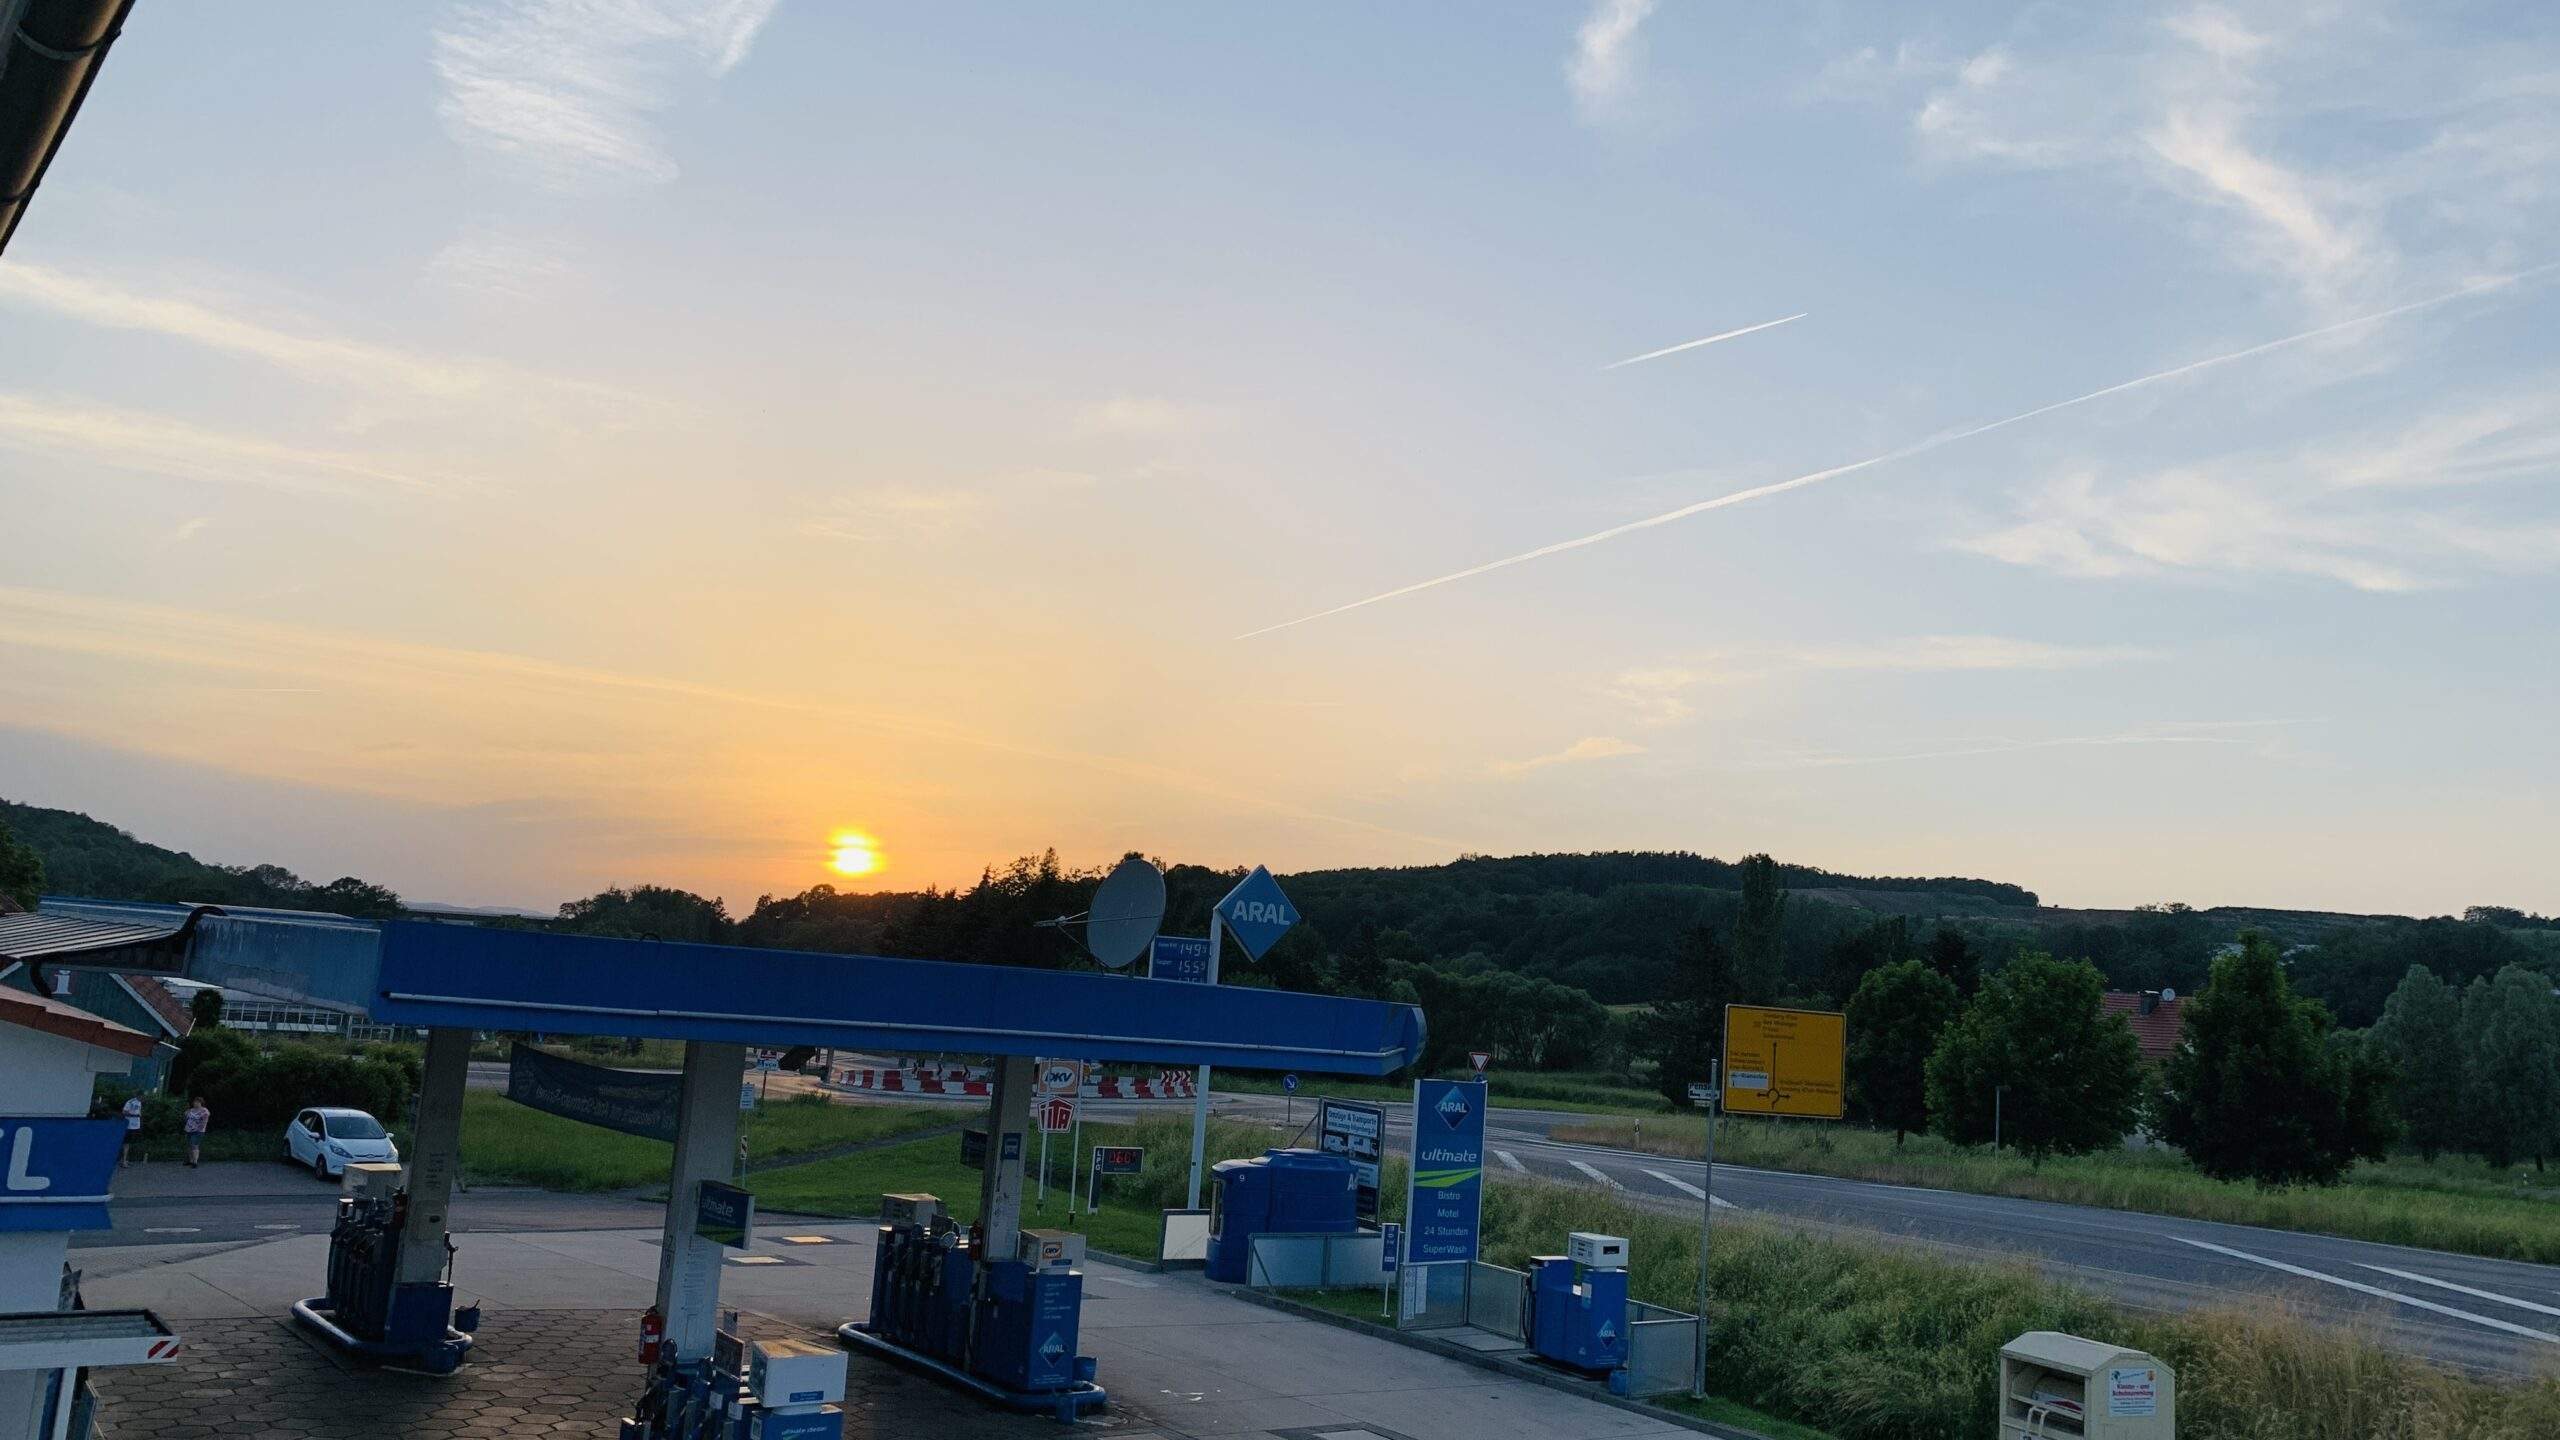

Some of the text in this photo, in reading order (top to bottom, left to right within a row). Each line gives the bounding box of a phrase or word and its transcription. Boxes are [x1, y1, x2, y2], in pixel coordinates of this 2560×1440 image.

[1231, 900, 1291, 926] ARAL
[1044, 1072, 1072, 1083] DKV
[1440, 1102, 1467, 1113] ARAL
[0, 1127, 50, 1190] L
[1421, 1149, 1477, 1163] ultimate
[1438, 1191, 1460, 1200] Bistro
[1437, 1208, 1459, 1218] Motel
[1424, 1227, 1468, 1236] 24 Stunden
[1423, 1244, 1468, 1255] SuperWash
[1600, 1329, 1616, 1338] ARAL
[1043, 1344, 1065, 1353] ARAL
